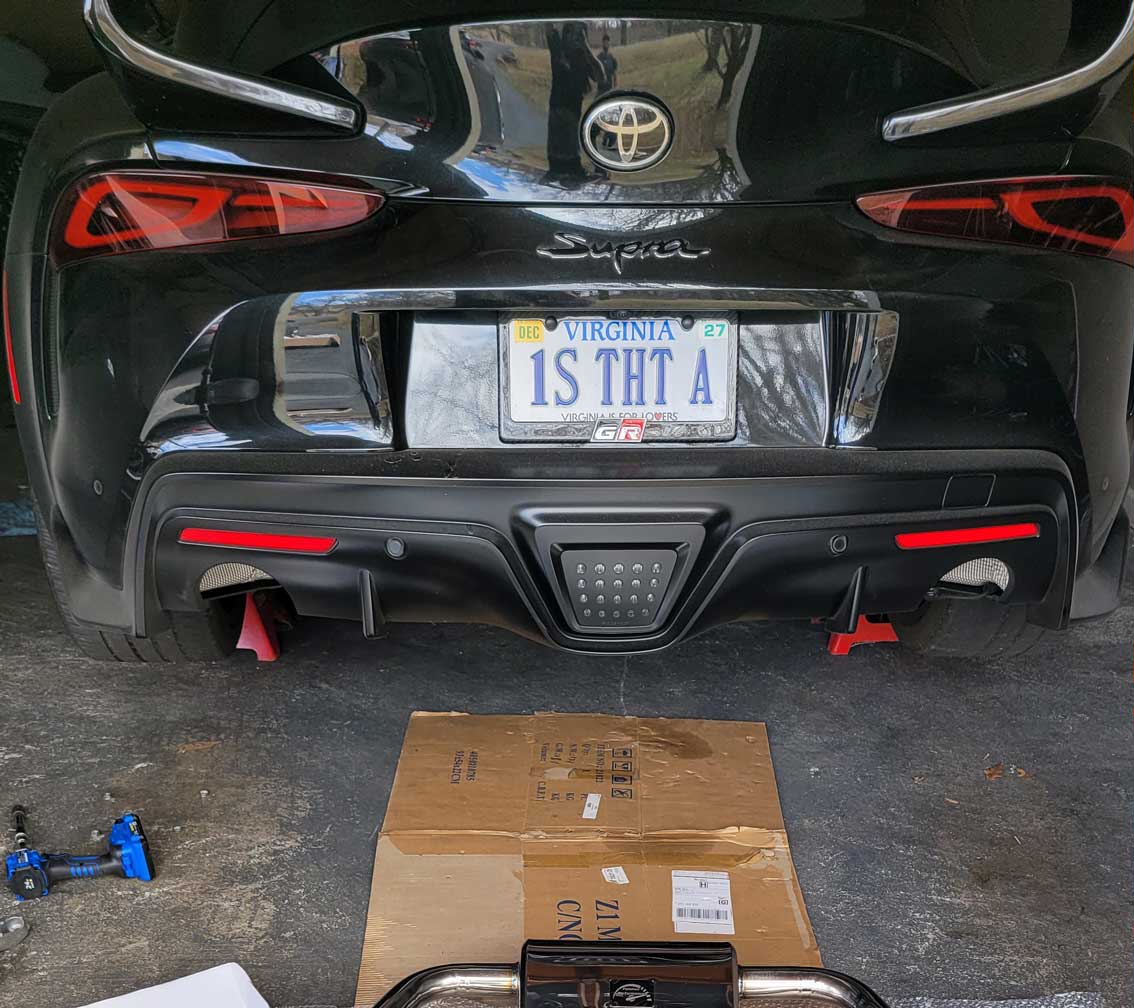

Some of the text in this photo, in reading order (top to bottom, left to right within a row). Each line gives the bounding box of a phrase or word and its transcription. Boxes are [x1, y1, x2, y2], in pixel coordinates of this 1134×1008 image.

[536, 232, 711, 275] Supra
[518, 325, 540, 339] DEC
[563, 320, 675, 342] VIRGINIA
[704, 323, 726, 337] 27
[530, 348, 713, 406] 1S THT A
[593, 423, 642, 441] GR
[595, 900, 620, 921] Z1
